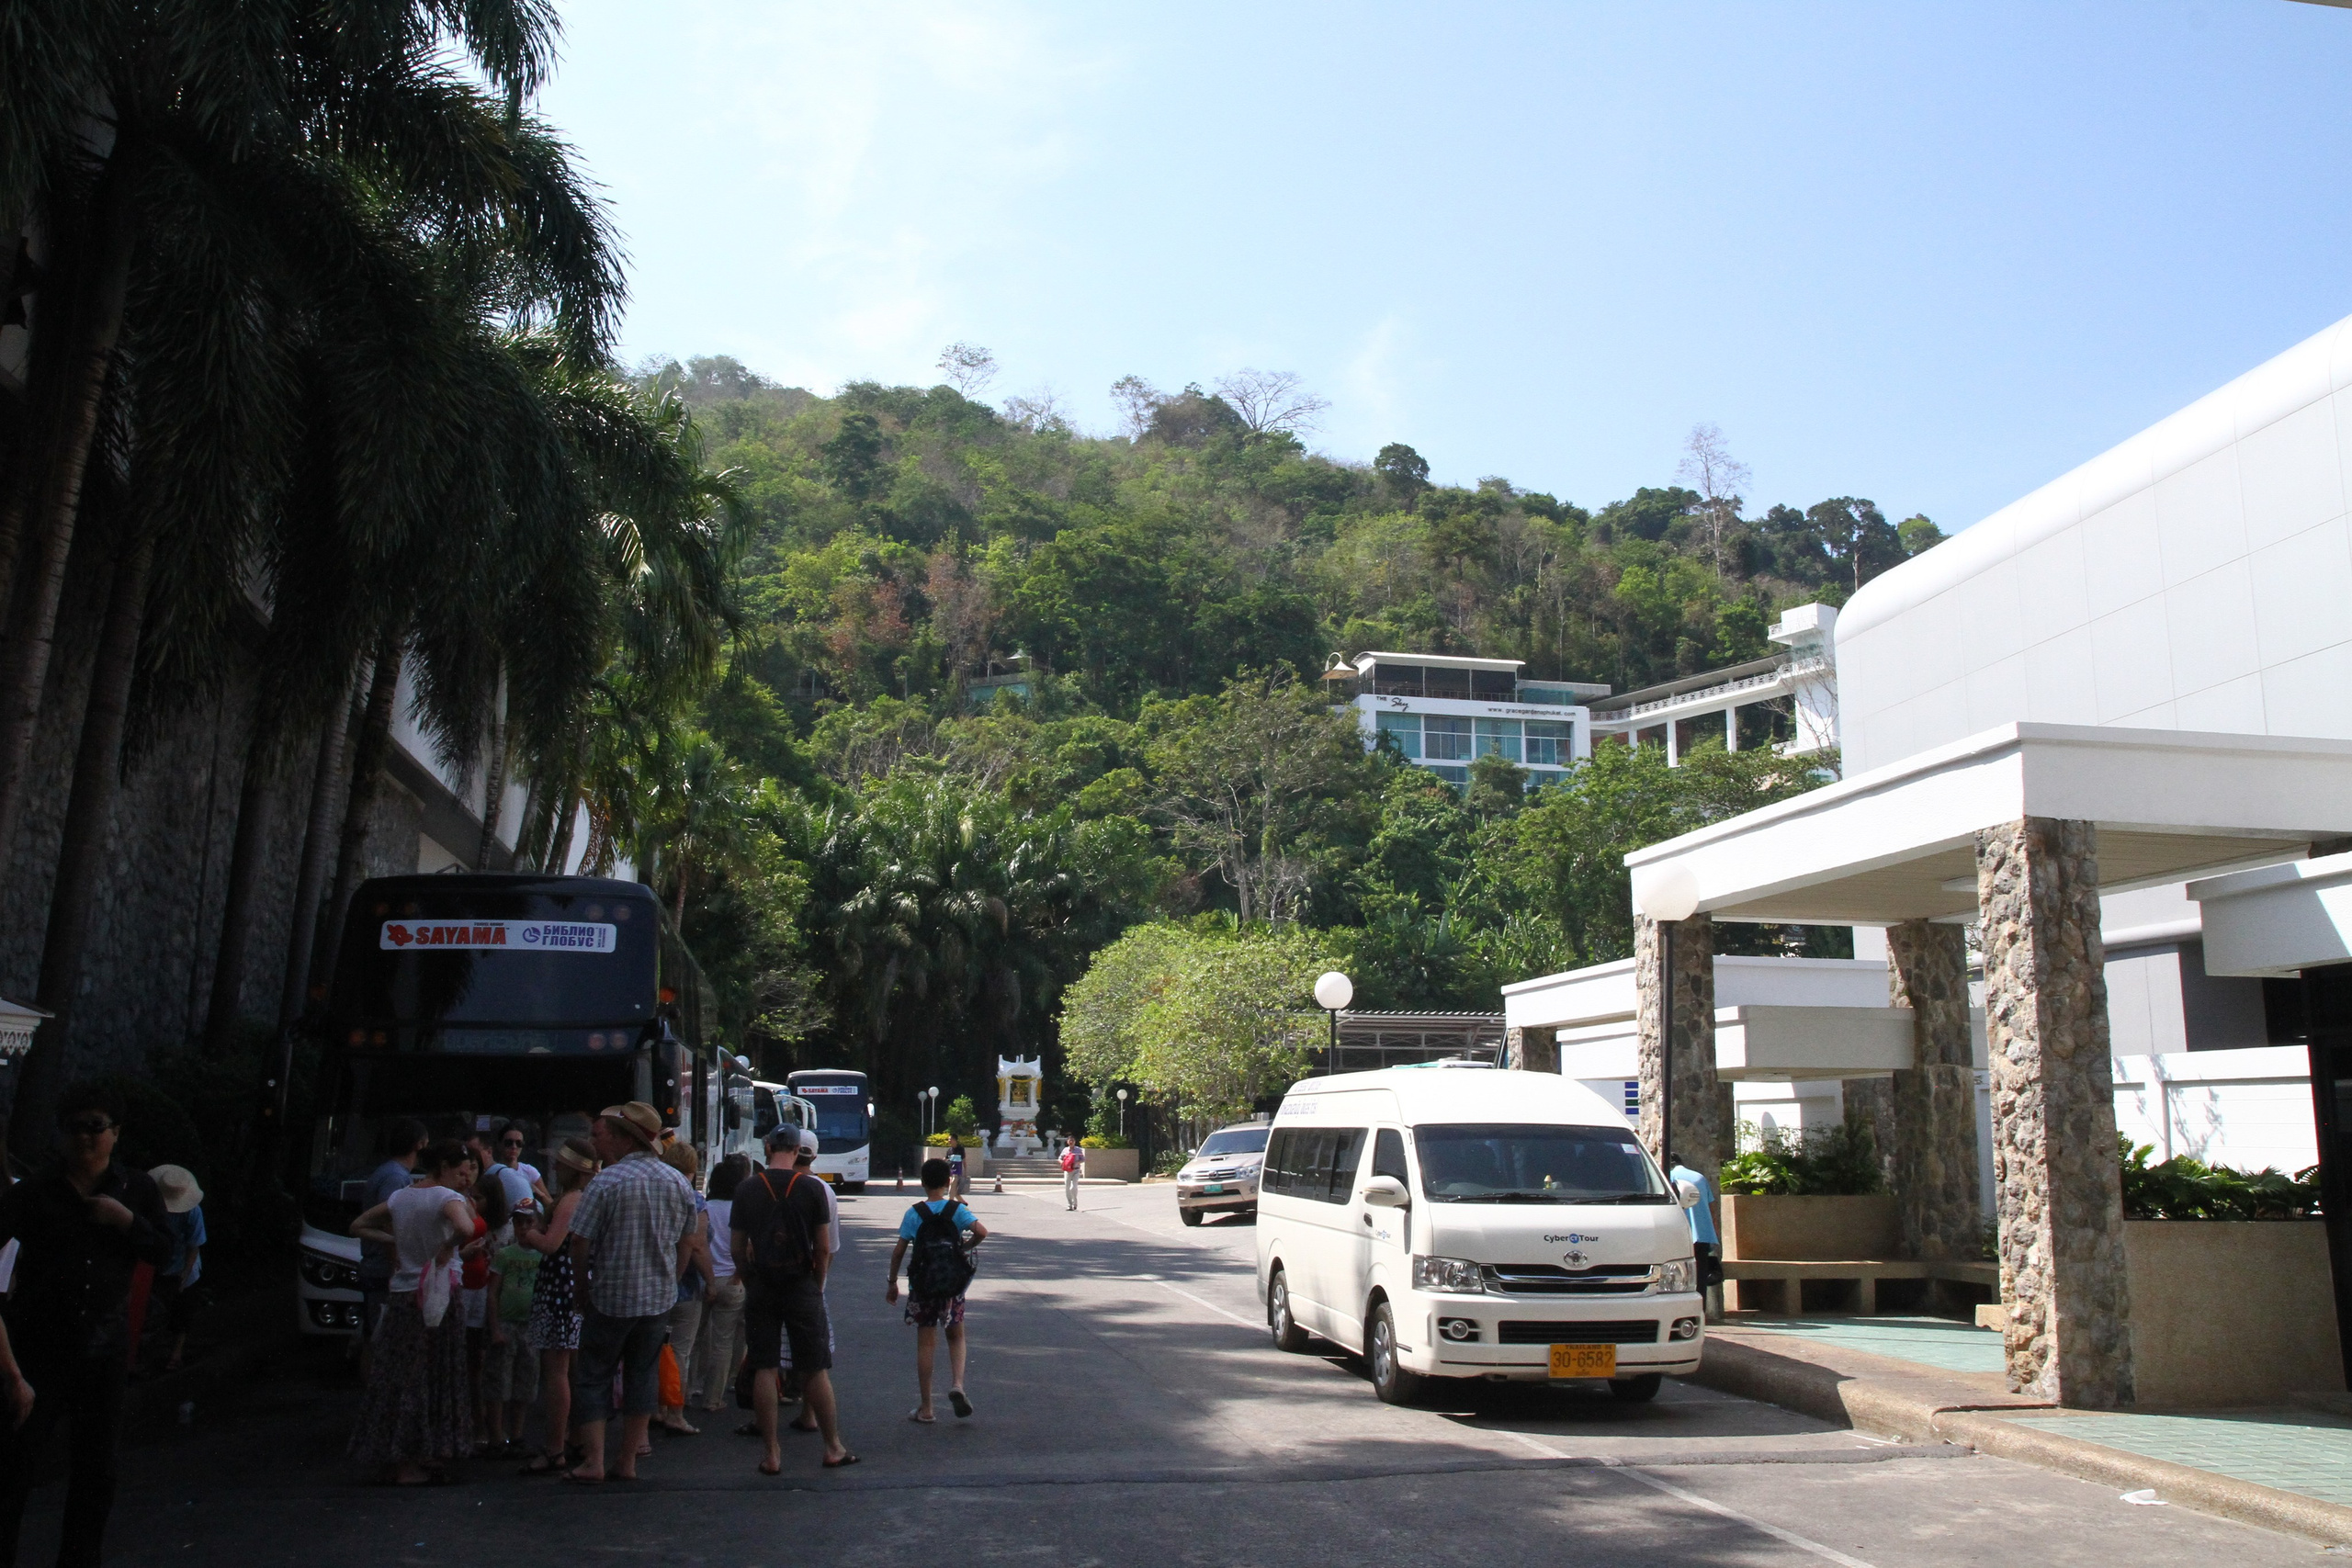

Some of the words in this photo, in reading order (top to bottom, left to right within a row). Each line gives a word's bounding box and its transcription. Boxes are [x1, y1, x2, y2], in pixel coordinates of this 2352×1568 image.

[1391, 696, 1409, 713] Sky
[415, 926, 507, 945] SAYAMA
[543, 925, 595, 937] БИБЛИО
[542, 935, 594, 948] ГЛОБУС
[1544, 1235, 1569, 1244] Cyber
[1553, 1350, 1613, 1369] 30-6582
